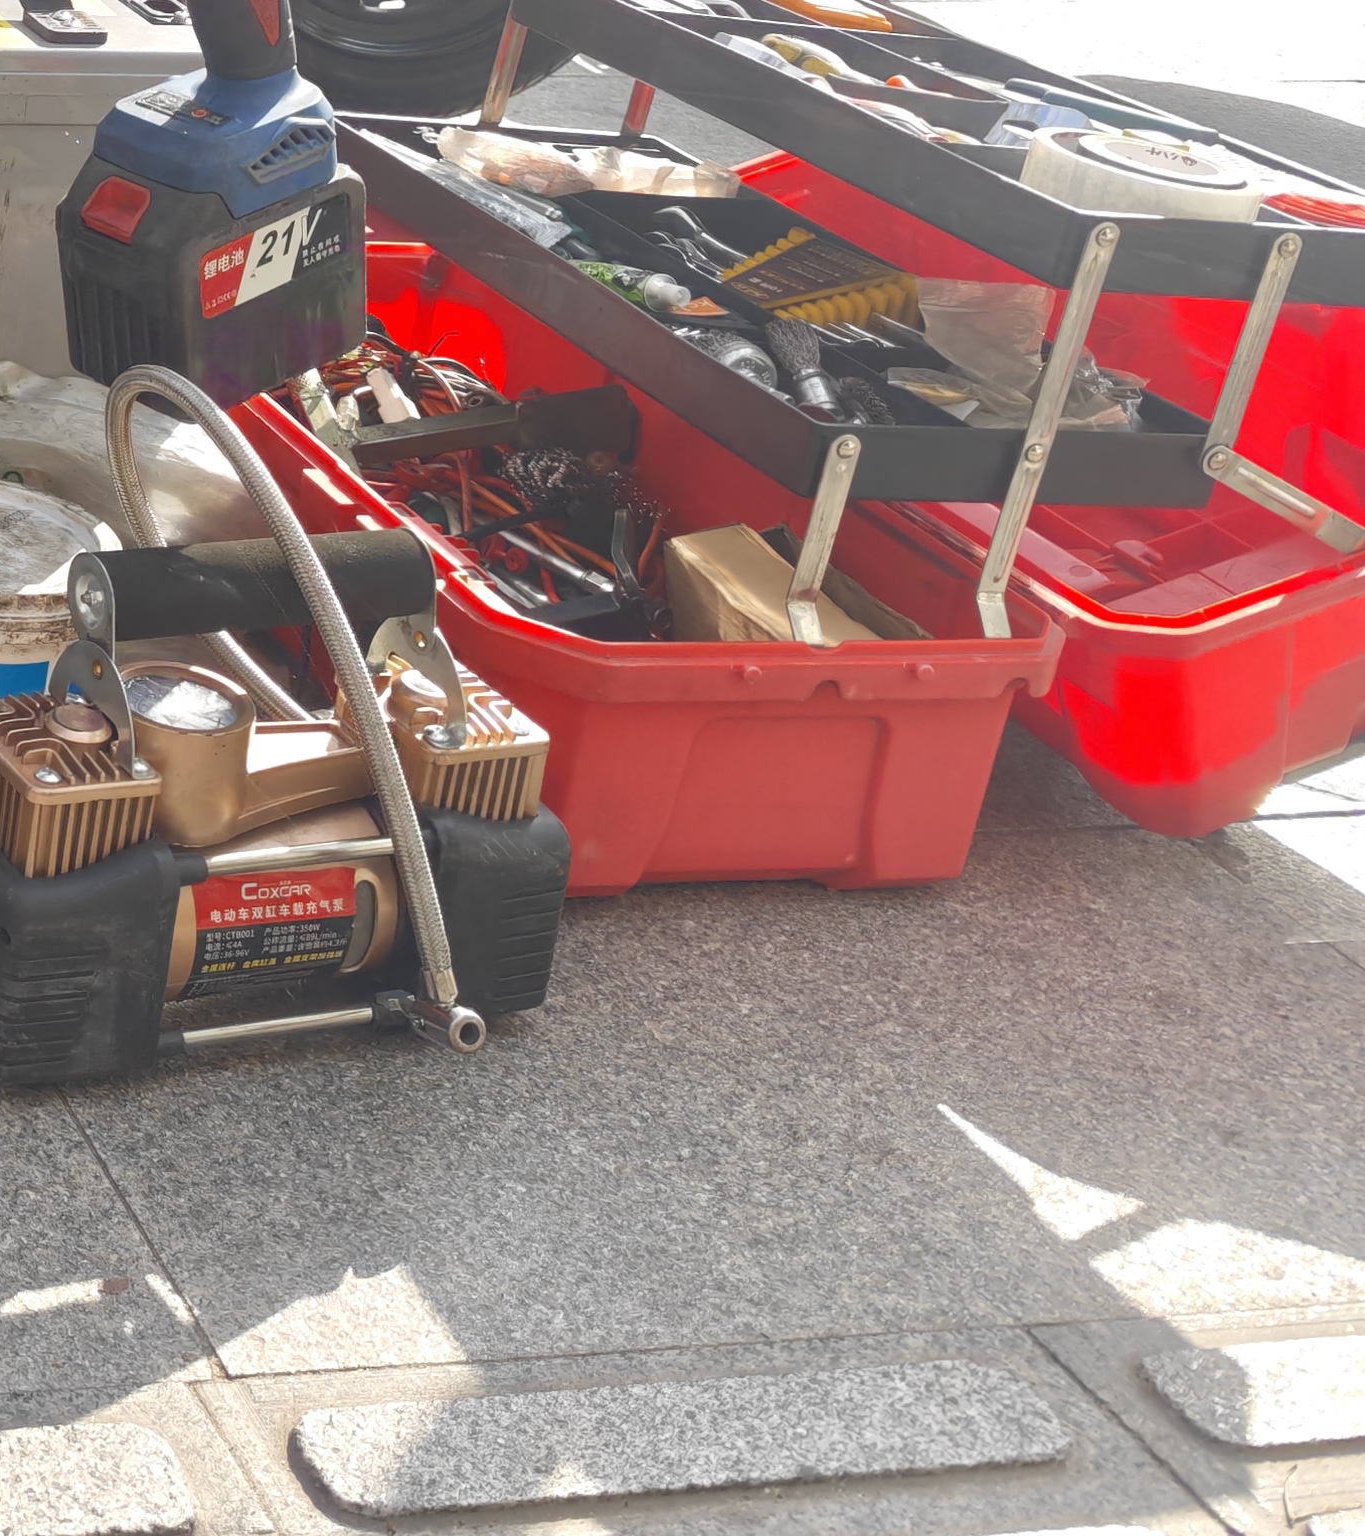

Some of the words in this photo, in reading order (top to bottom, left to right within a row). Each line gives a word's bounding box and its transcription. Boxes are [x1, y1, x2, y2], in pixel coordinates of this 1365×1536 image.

[203, 246, 245, 280] 锂电池
[256, 208, 323, 270] 21V
[210, 898, 345, 924] 电动车双缸车载充气泵
